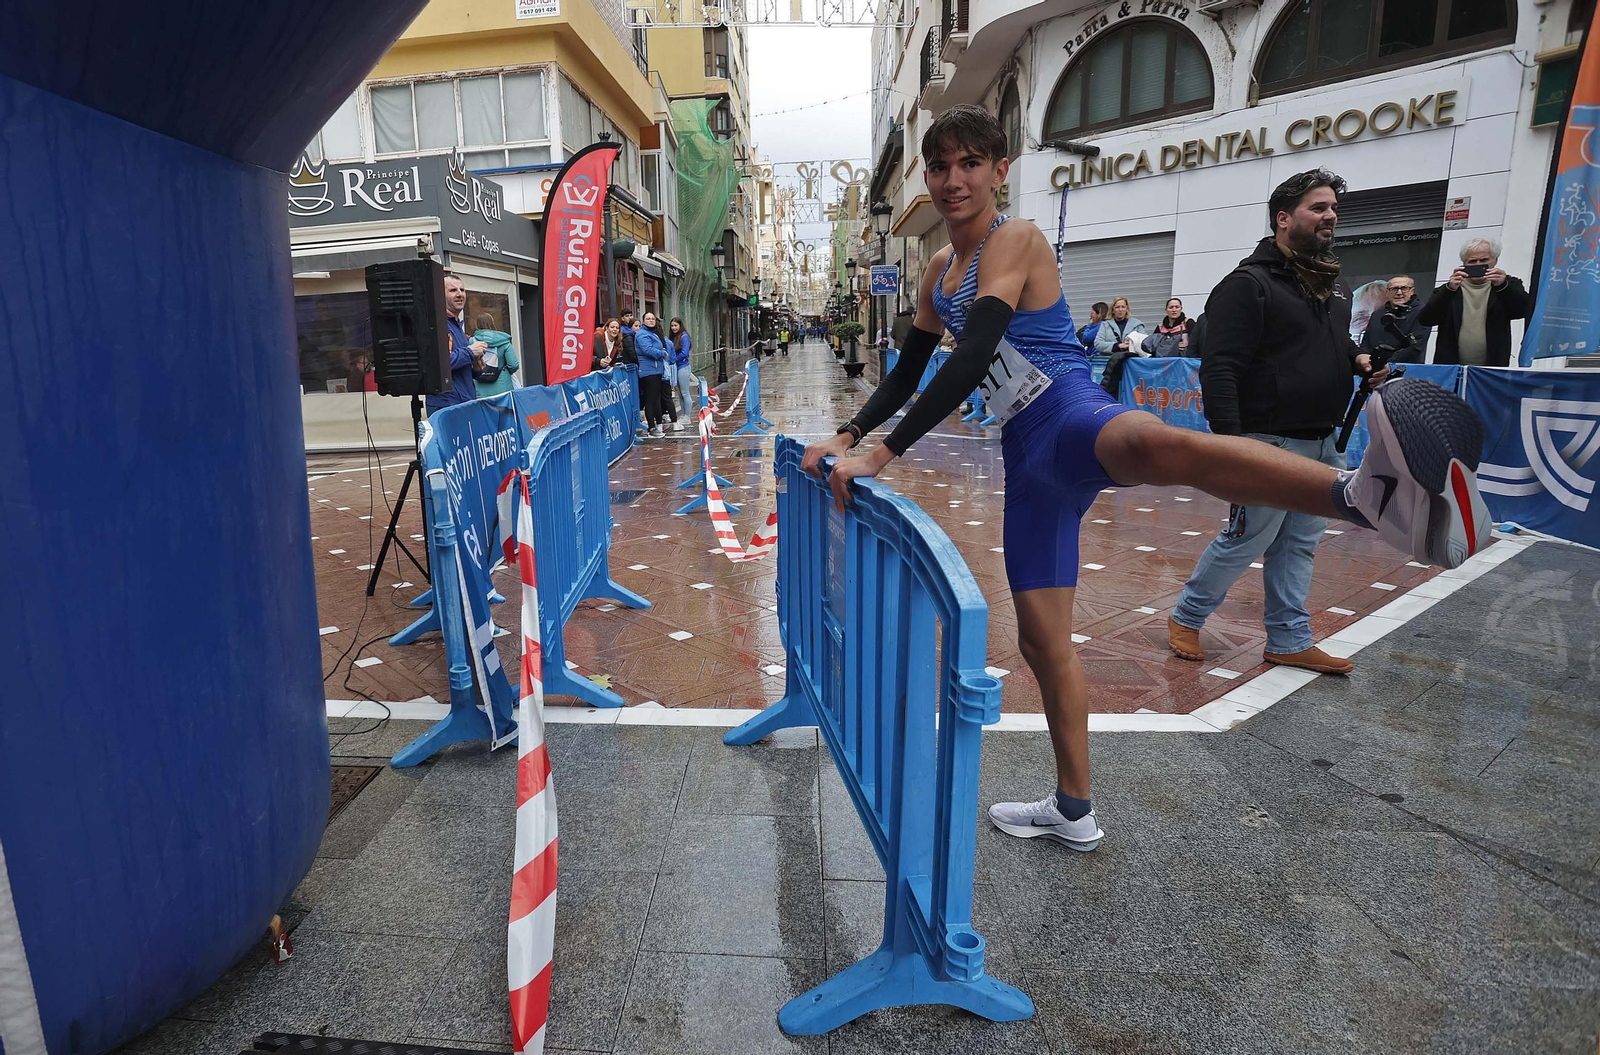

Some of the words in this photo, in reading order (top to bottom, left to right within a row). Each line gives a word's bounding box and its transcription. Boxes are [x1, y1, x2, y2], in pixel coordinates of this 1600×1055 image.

[1117, 1, 1132, 19] &
[1160, 127, 1275, 172] DENTAL
[1285, 90, 1458, 150] CROOKE
[338, 166, 424, 212] Real
[366, 169, 410, 179] Principe
[471, 176, 502, 224] Real
[462, 229, 477, 248] Café
[481, 234, 500, 255] Copas
[566, 218, 593, 279] Ruiz
[1359, 236, 1397, 245] Periodoncia
[1402, 232, 1439, 241] Cosmética
[555, 218, 570, 315] SUPERMERCADOS
[561, 285, 587, 371] Galán
